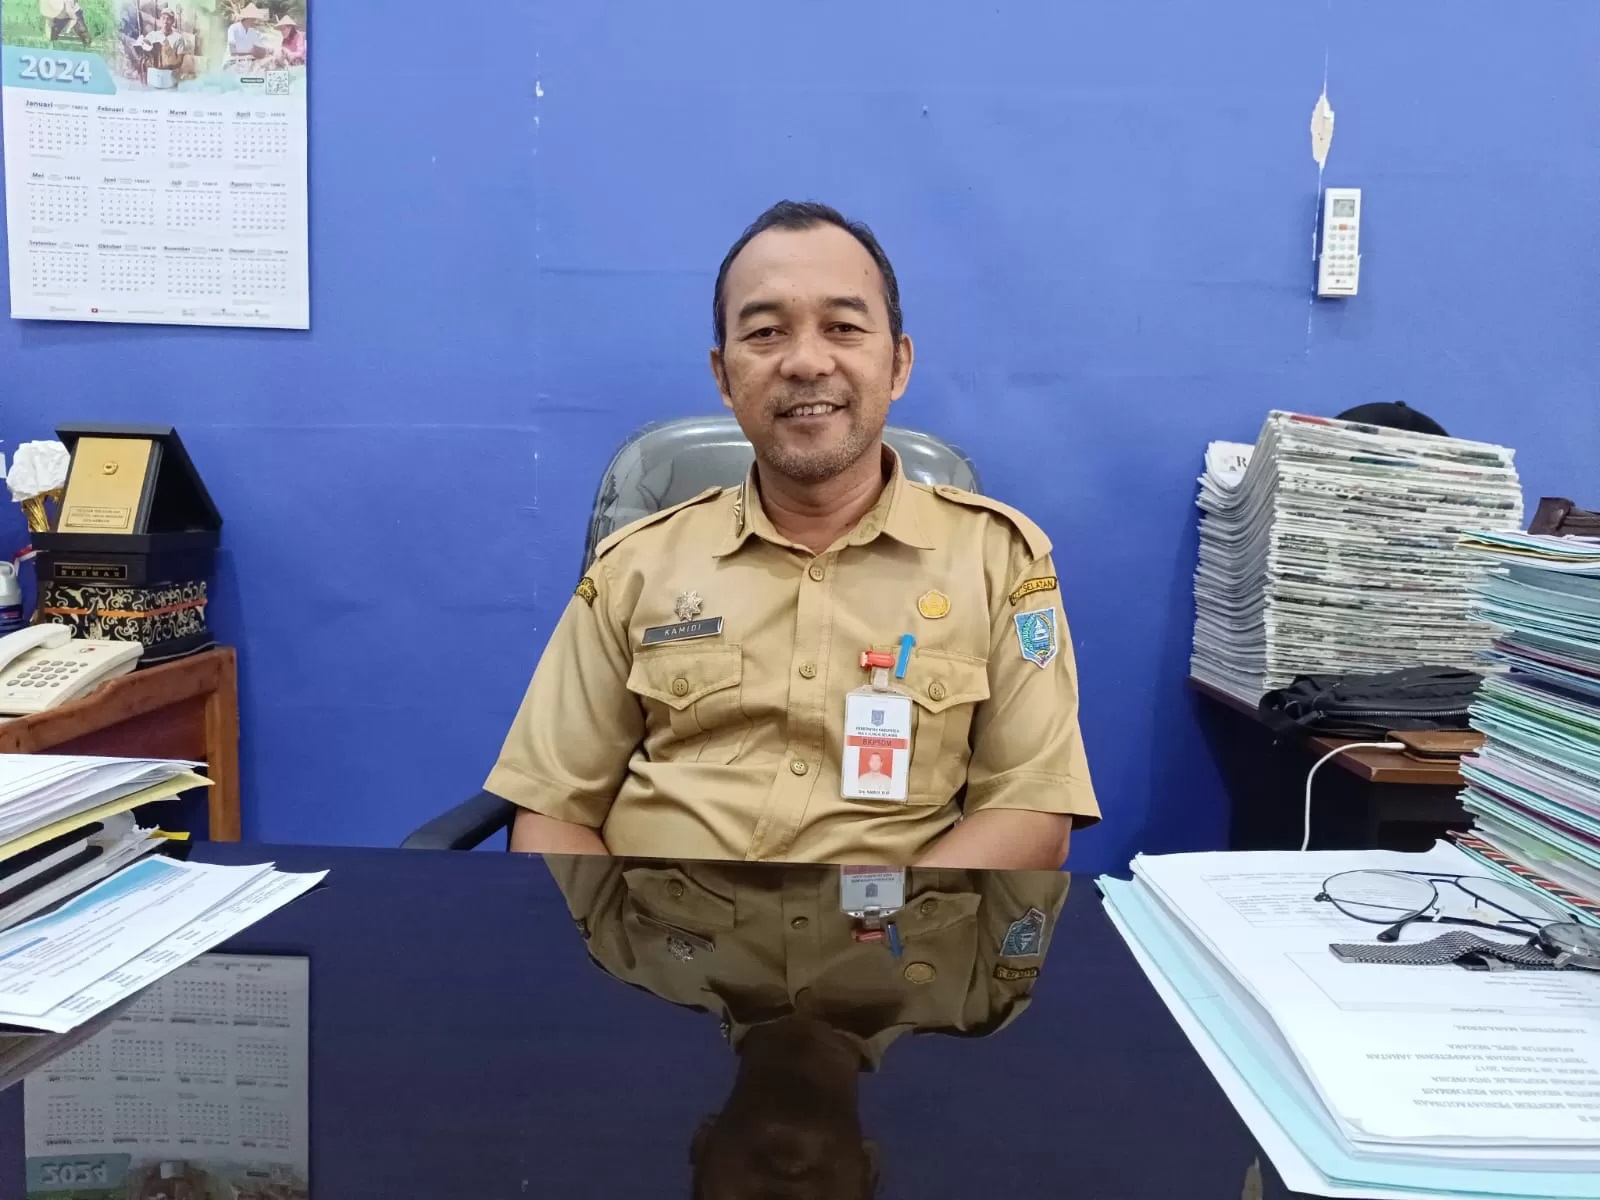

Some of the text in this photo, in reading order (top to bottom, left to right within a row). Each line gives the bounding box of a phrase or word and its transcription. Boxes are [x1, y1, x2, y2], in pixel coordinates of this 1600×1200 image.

[20, 55, 93, 83] 2024
[25, 100, 54, 108] Januari
[97, 105, 124, 113] Februari
[1023, 578, 1054, 593] SELATAN
[664, 623, 702, 636] KAMIDI
